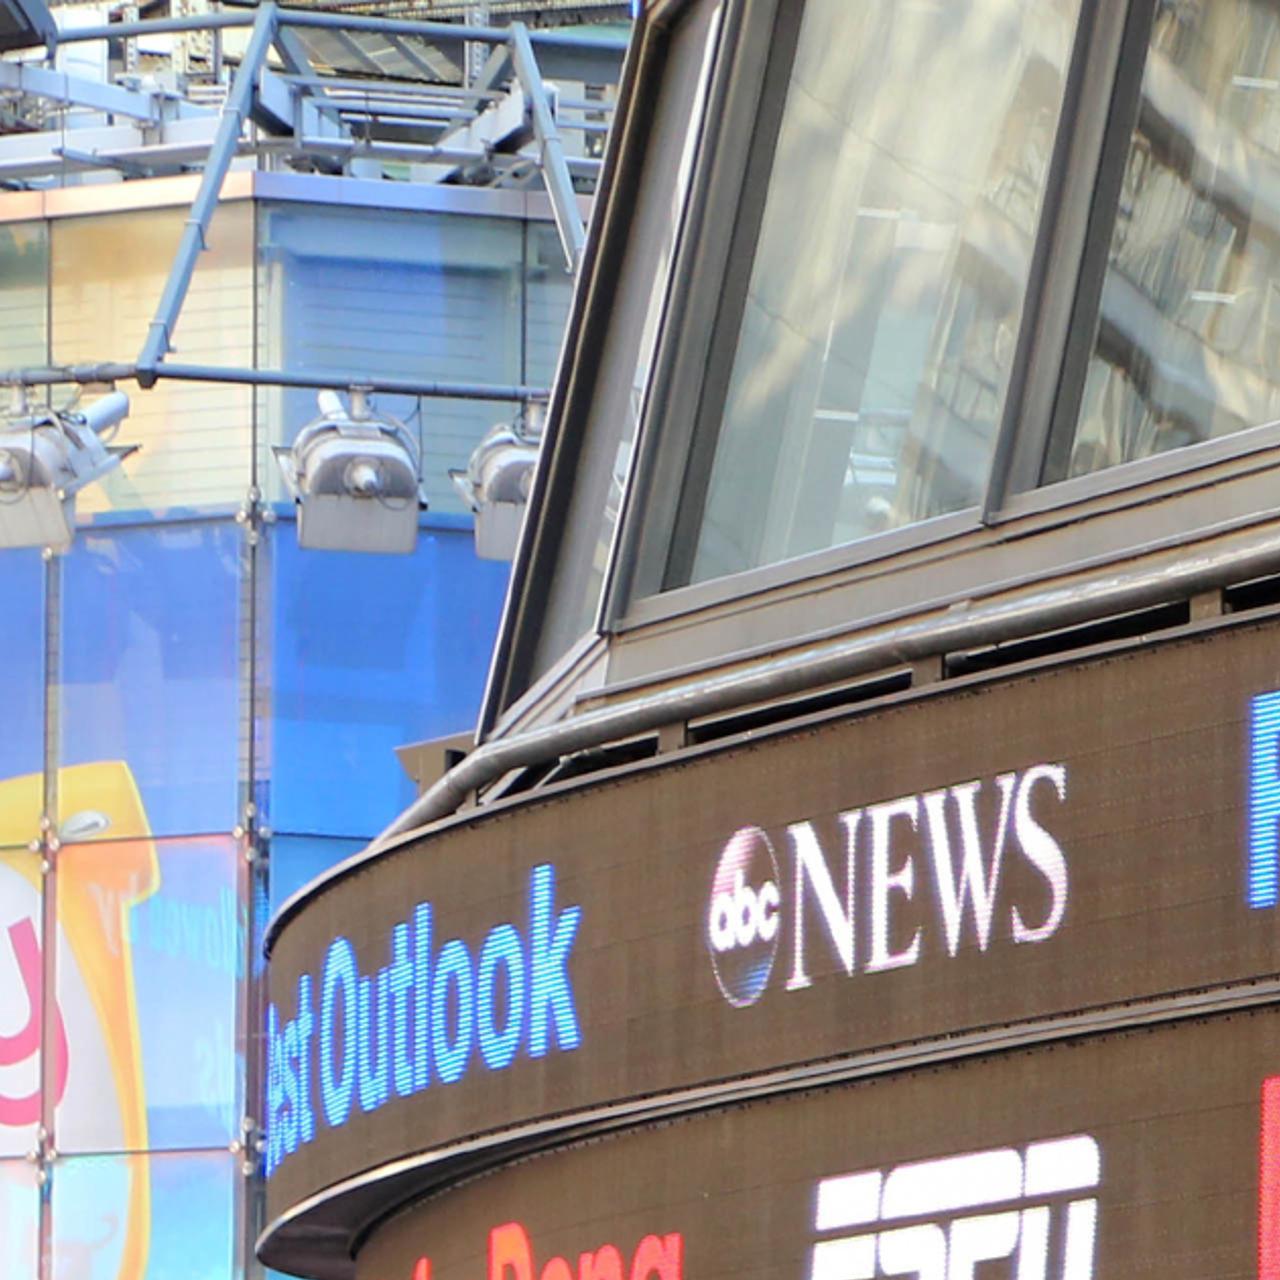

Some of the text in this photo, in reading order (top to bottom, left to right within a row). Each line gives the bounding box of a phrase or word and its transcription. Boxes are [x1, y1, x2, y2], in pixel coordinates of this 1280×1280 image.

[320, 862, 583, 1127] Outlook
[709, 764, 1069, 991] abc NEWS
